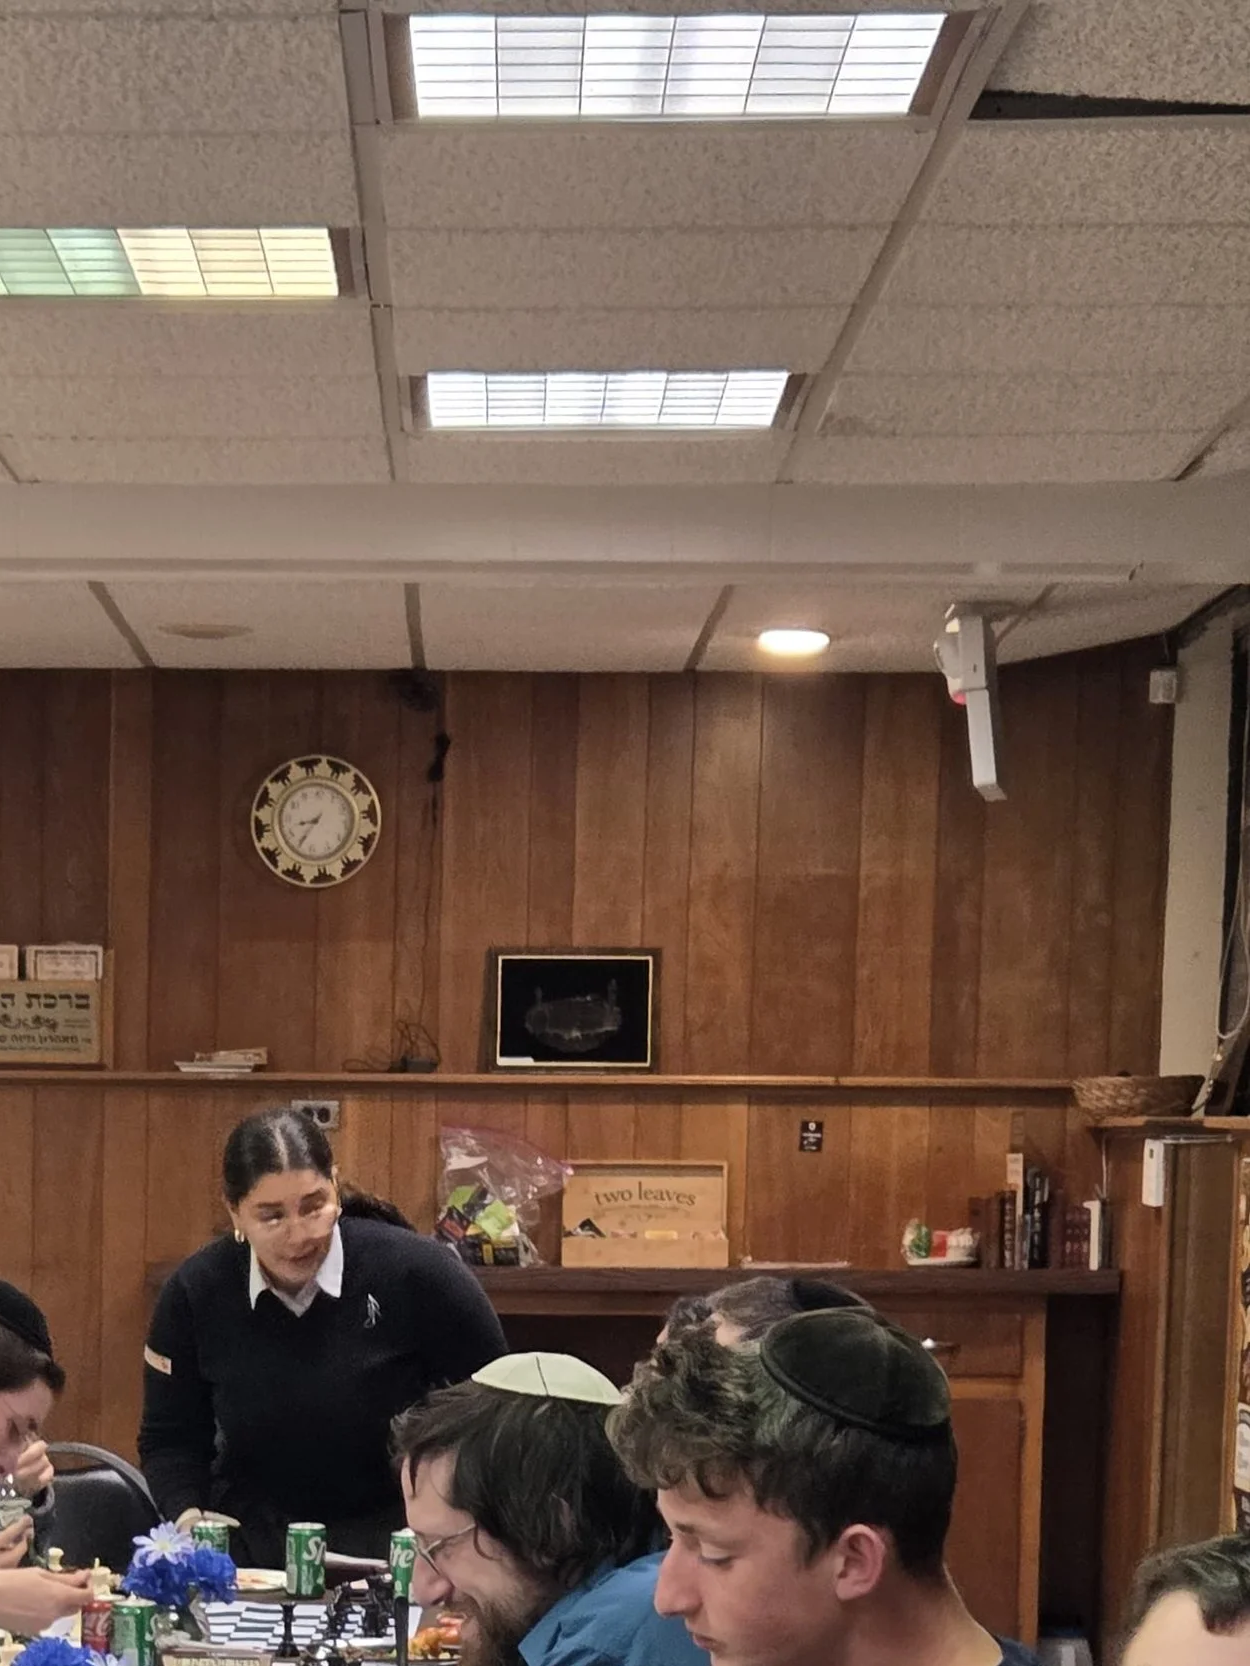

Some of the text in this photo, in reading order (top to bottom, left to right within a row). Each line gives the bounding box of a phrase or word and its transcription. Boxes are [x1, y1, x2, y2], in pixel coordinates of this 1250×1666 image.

[26, 992, 90, 1009] ברכת
[594, 1181, 697, 1206] two leaves
